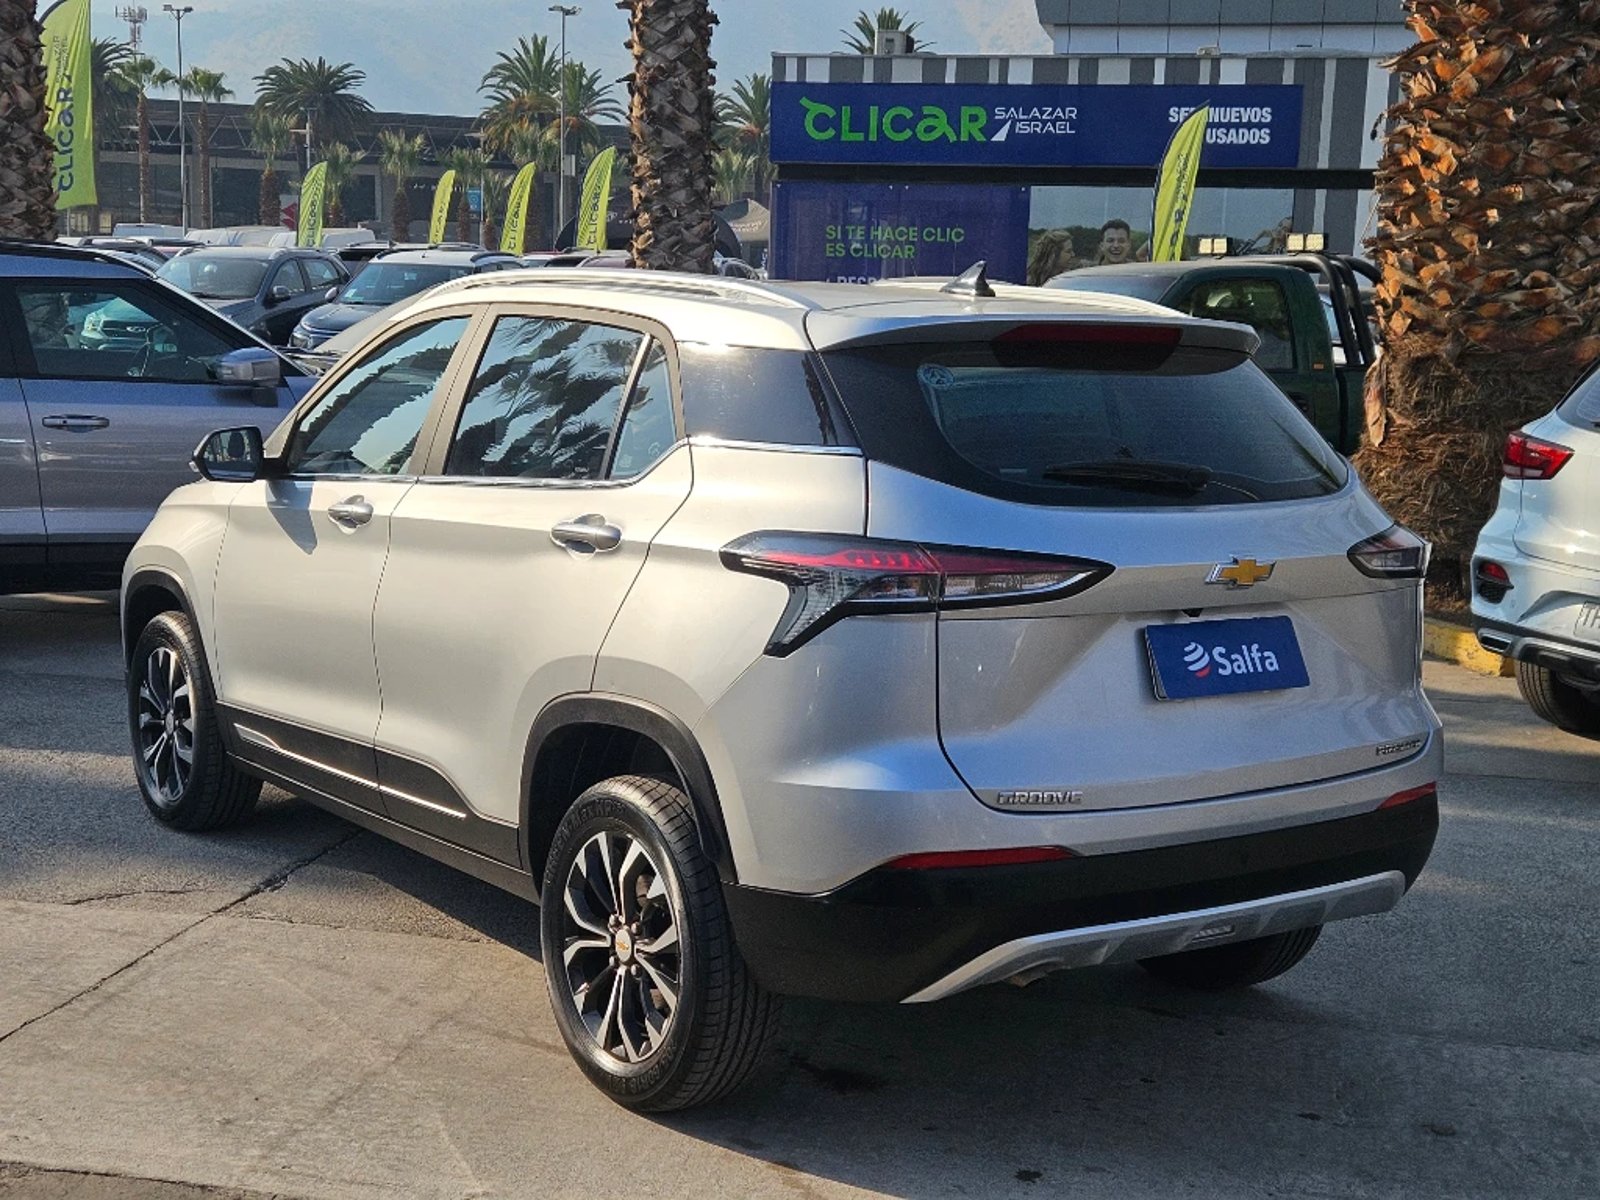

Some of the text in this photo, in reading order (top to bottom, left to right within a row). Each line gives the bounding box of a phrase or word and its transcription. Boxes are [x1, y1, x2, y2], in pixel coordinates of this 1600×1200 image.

[994, 106, 1078, 120] SALAZAR
[1168, 106, 1272, 123] SENUEVOS
[1015, 121, 1076, 134] ISRAEL
[1205, 127, 1271, 144] USADOS
[825, 225, 965, 243] SI TE HACE CLIC
[825, 243, 915, 258] ES CLICAR
[1212, 642, 1279, 676] Salfa
[997, 790, 1084, 805] GROOVE
